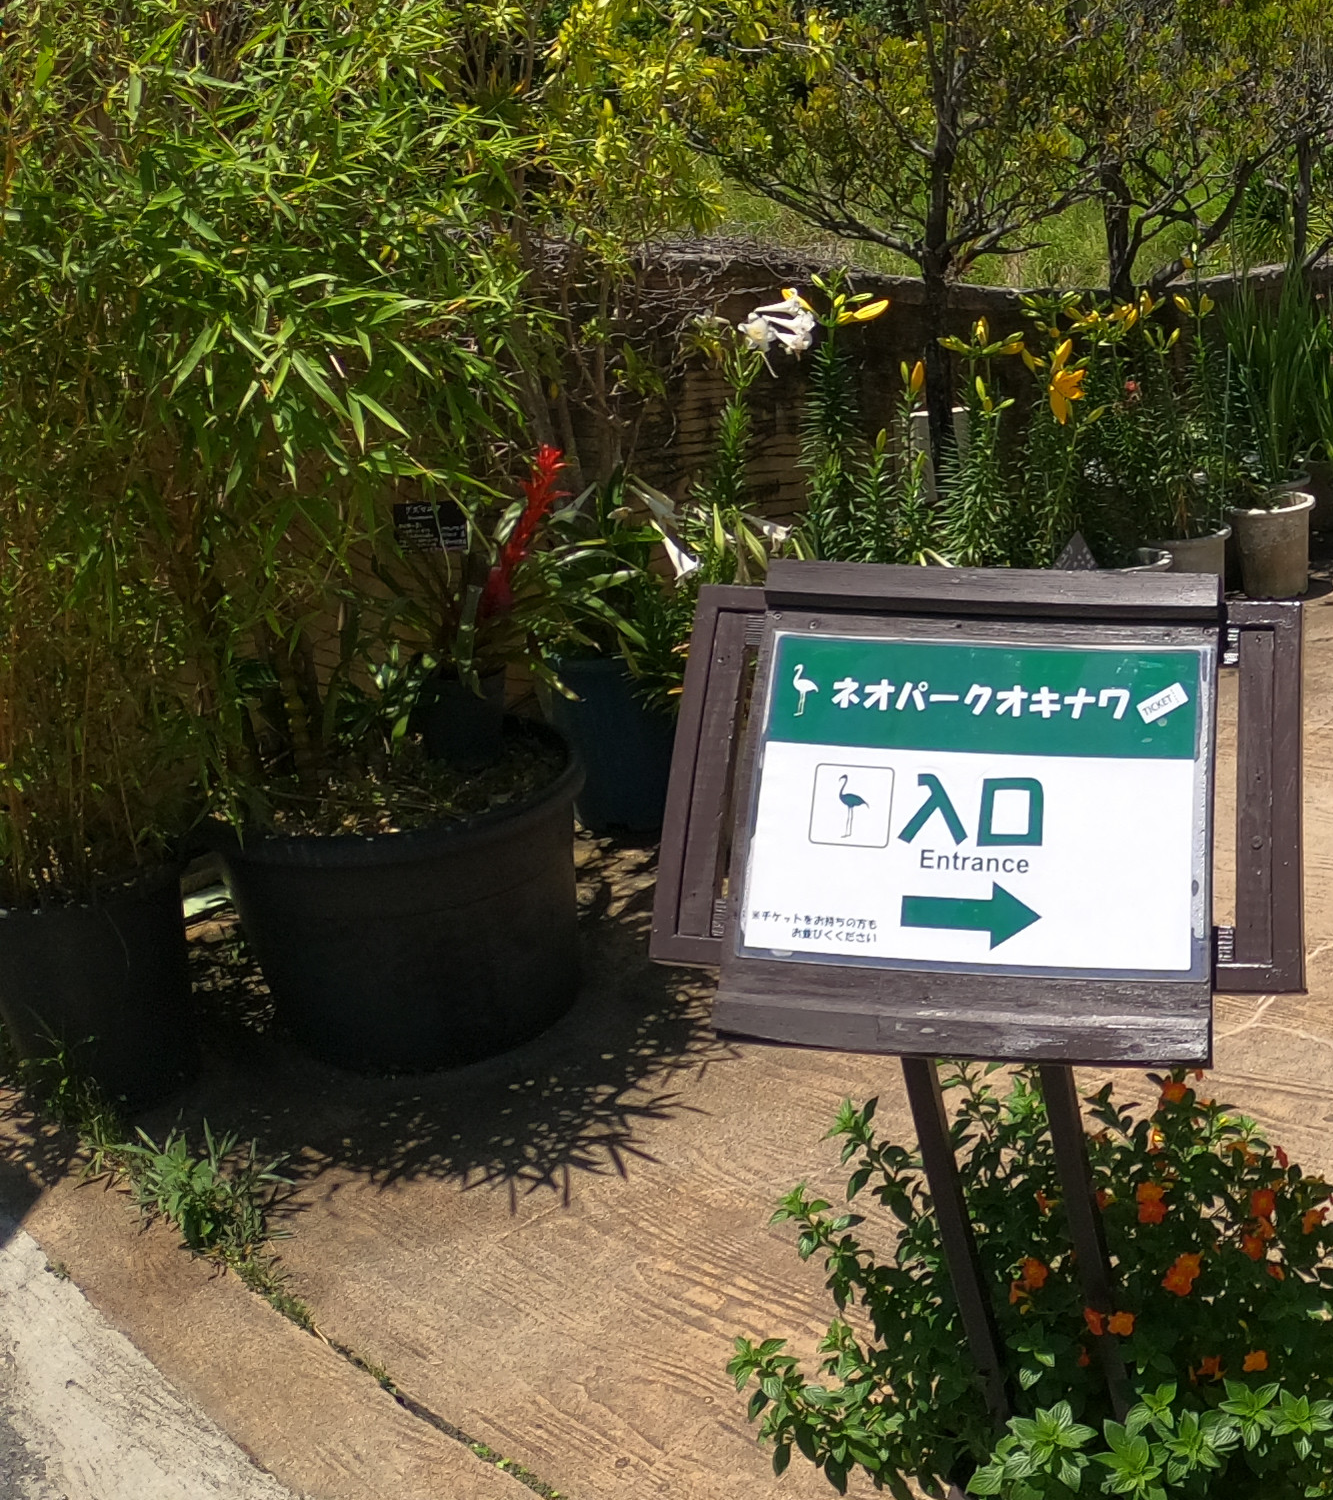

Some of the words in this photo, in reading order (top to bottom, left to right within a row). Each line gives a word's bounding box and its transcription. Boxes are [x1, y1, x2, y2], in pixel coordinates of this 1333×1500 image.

[831, 677, 1130, 720] ネオパークオキナワ
[1142, 694, 1173, 716] TICKET
[898, 773, 1044, 846] 入口
[920, 849, 1030, 874] Entrance
